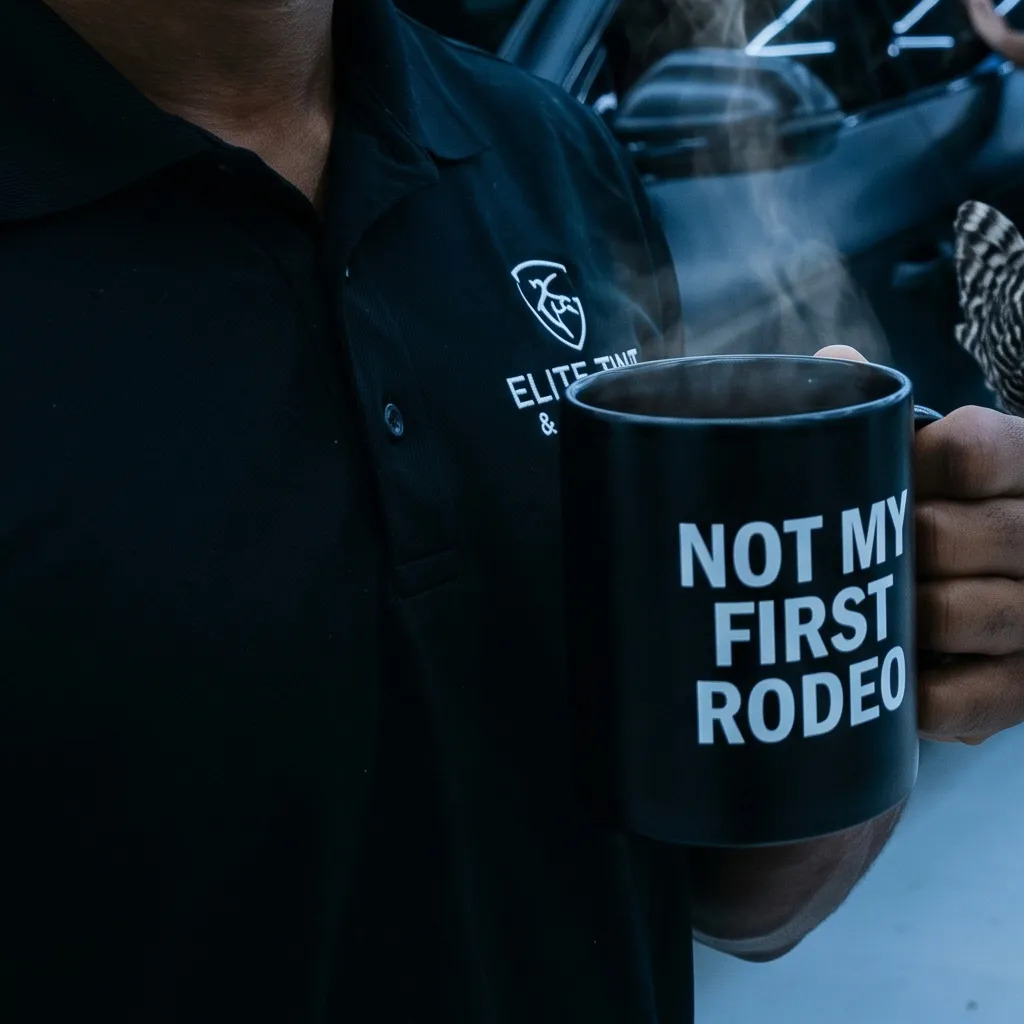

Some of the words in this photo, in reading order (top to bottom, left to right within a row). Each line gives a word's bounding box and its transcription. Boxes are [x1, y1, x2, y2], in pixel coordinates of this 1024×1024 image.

[506, 361, 588, 409] ELITE
[539, 412, 558, 436] &
[679, 515, 823, 588] NOT
[841, 488, 908, 575] MY
[714, 574, 894, 667] FIRST
[697, 645, 906, 745] RODEO
